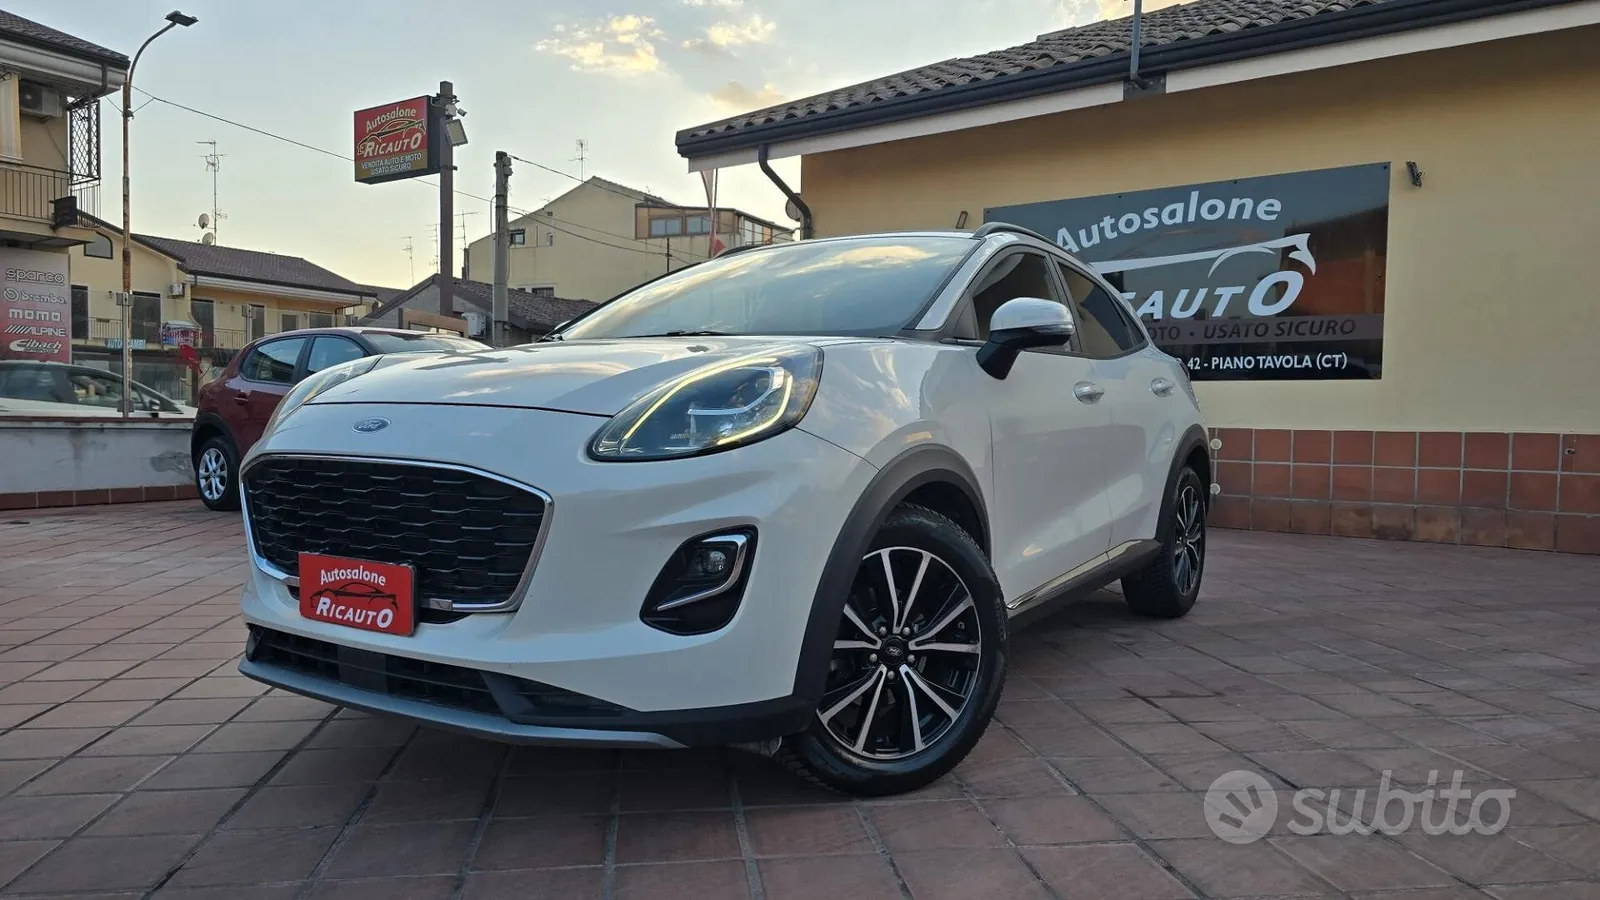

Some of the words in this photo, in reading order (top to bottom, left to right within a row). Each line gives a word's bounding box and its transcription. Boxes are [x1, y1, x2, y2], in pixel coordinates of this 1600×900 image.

[366, 106, 417, 133] Autosalone
[363, 132, 423, 157] RICAUTO
[405, 152, 422, 161] MOTO
[1056, 190, 1282, 253] Autosalone
[6, 268, 65, 284] sparco
[1203, 322, 1270, 339] USATO
[1274, 318, 1357, 337] SICURO
[1187, 357, 1201, 370] 42
[1211, 355, 1255, 370] PIANO
[1256, 354, 1313, 369] TAVOLA
[1316, 352, 1348, 370] (CT)
[320, 565, 387, 586] Autosalone
[316, 596, 394, 629] RICAUTO
